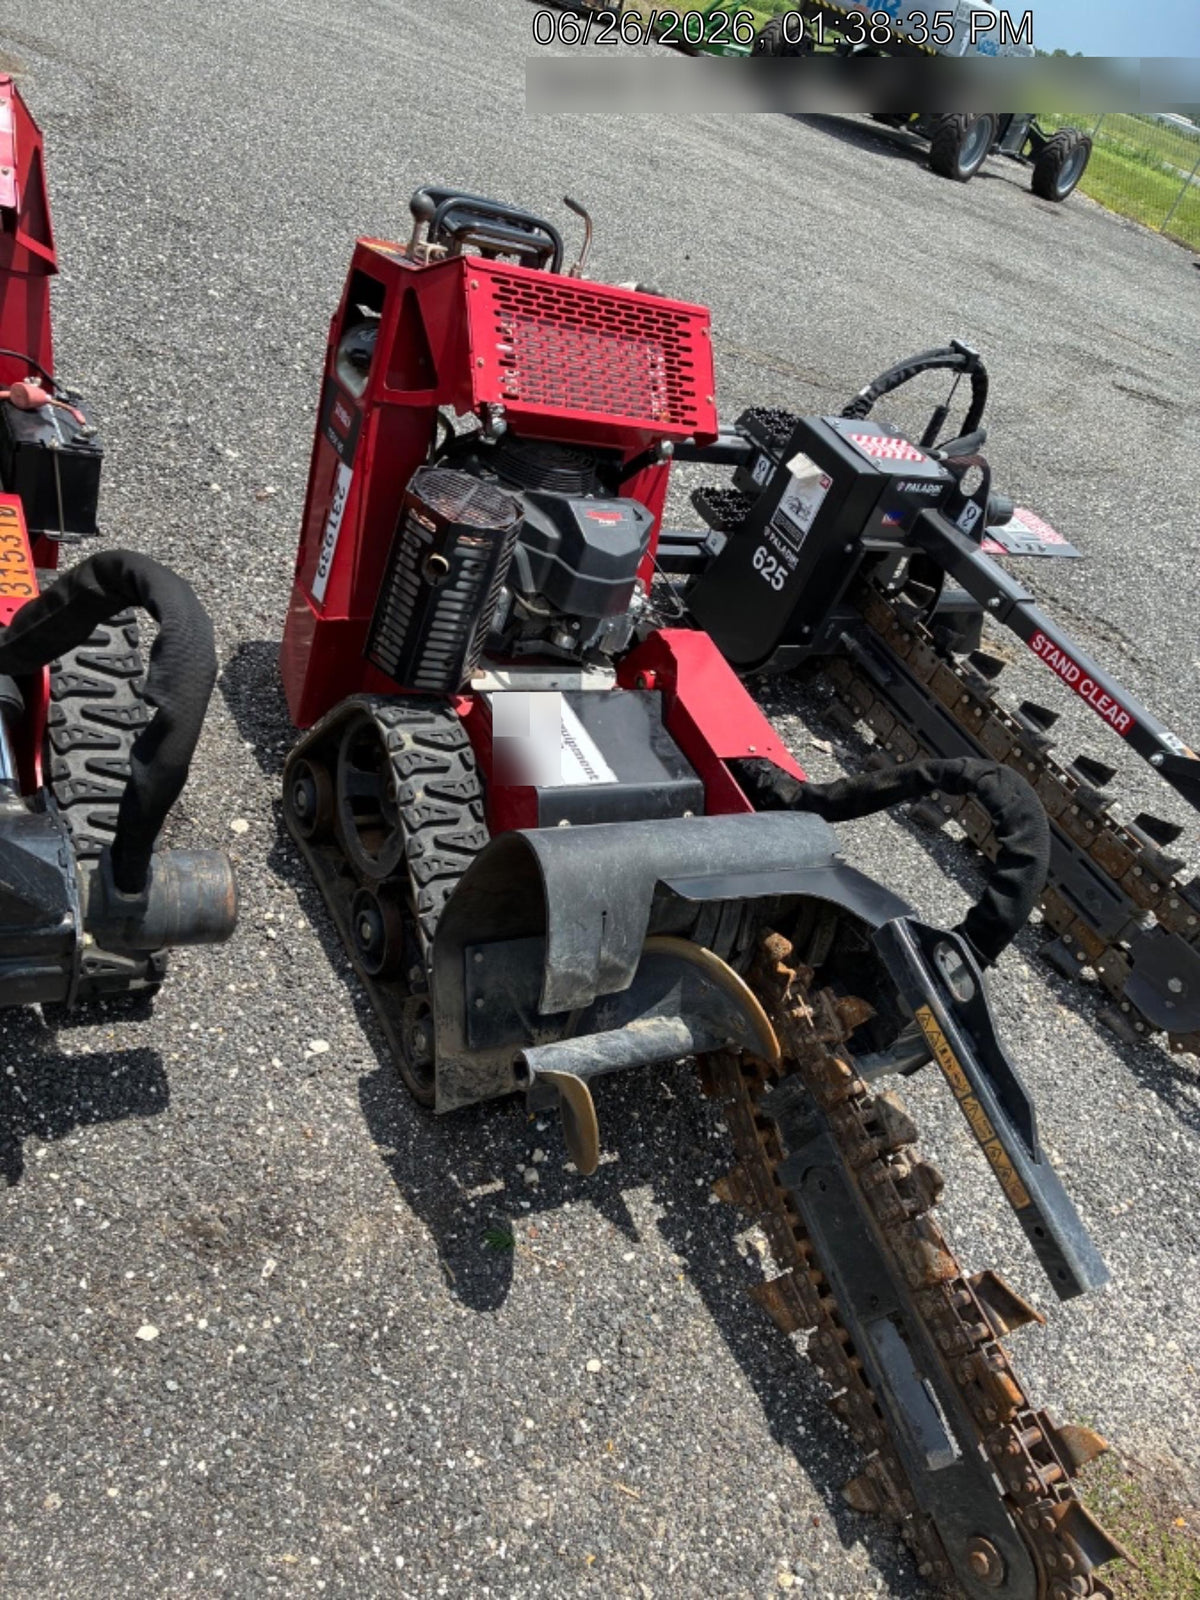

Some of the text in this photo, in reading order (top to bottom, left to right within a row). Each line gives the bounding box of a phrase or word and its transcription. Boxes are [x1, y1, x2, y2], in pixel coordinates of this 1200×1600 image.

[752, 545, 789, 591] 625
[1032, 634, 1131, 731] STAND CLEAR
